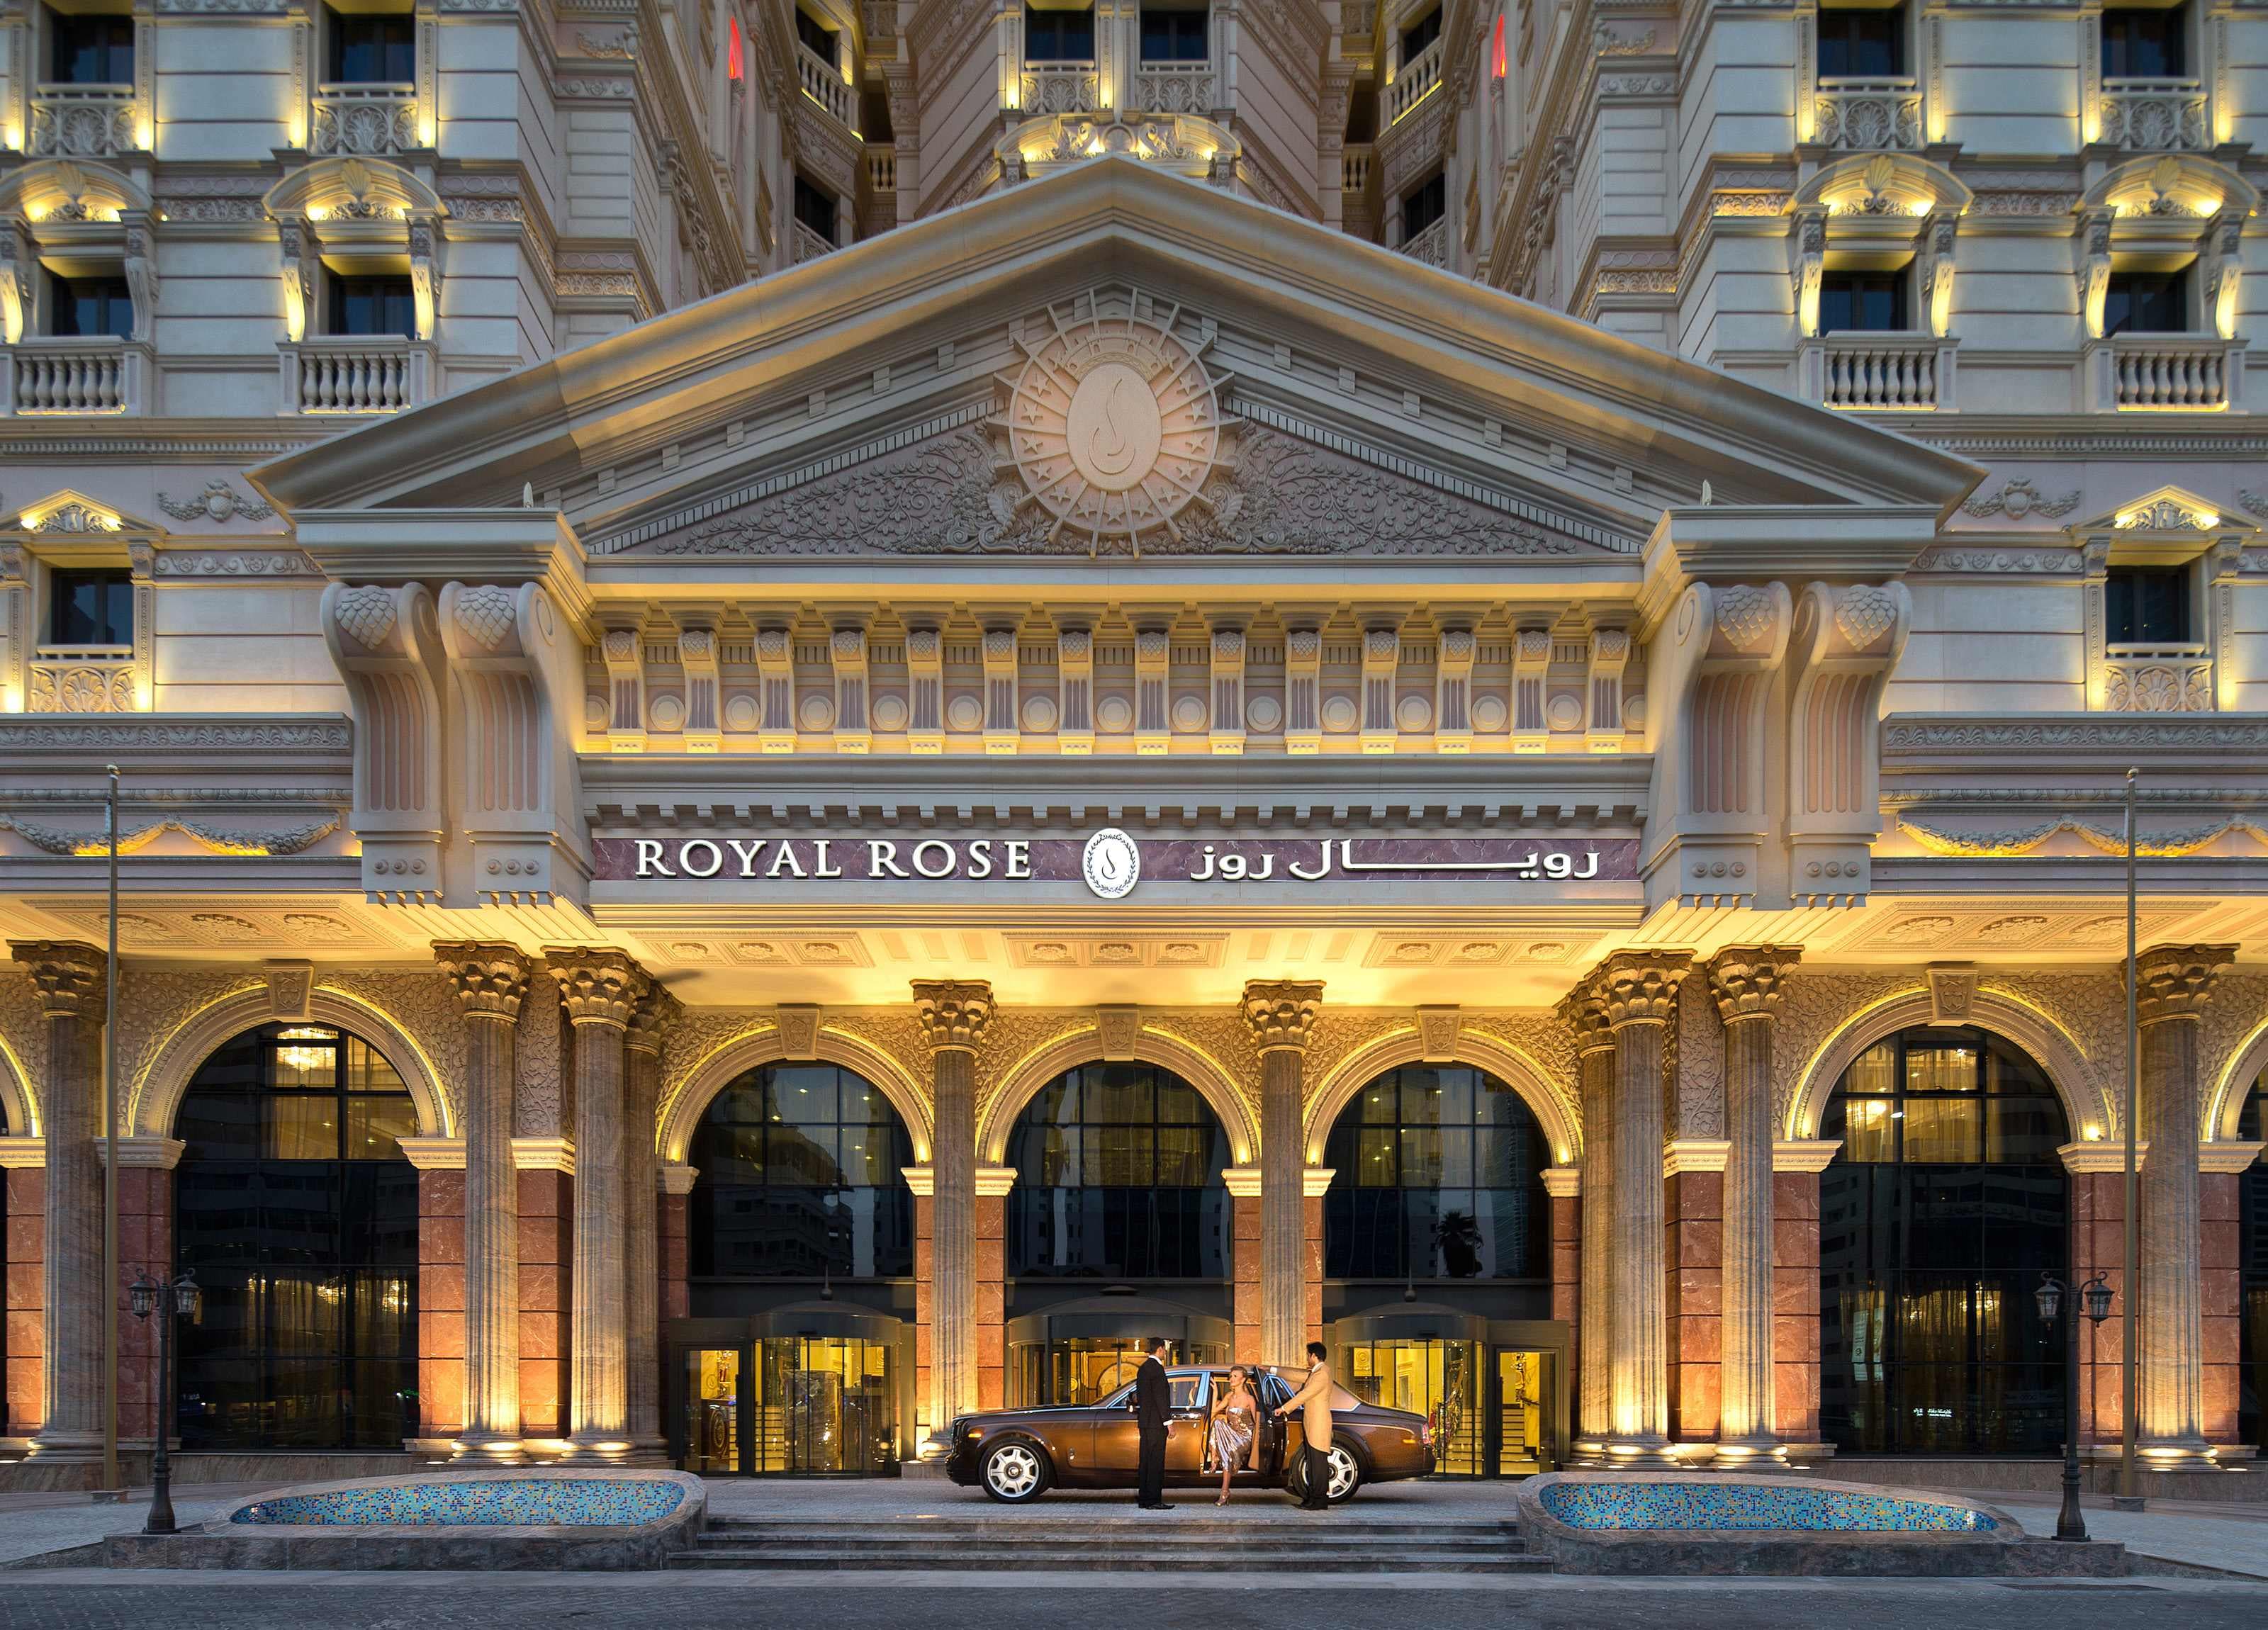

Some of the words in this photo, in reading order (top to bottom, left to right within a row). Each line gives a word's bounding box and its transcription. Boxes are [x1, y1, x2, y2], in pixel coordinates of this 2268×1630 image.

[634, 839, 842, 877] ROYAL
[867, 839, 1031, 877] ROSE
[1189, 845, 1275, 879] روز
[1289, 838, 1601, 879] رويال
